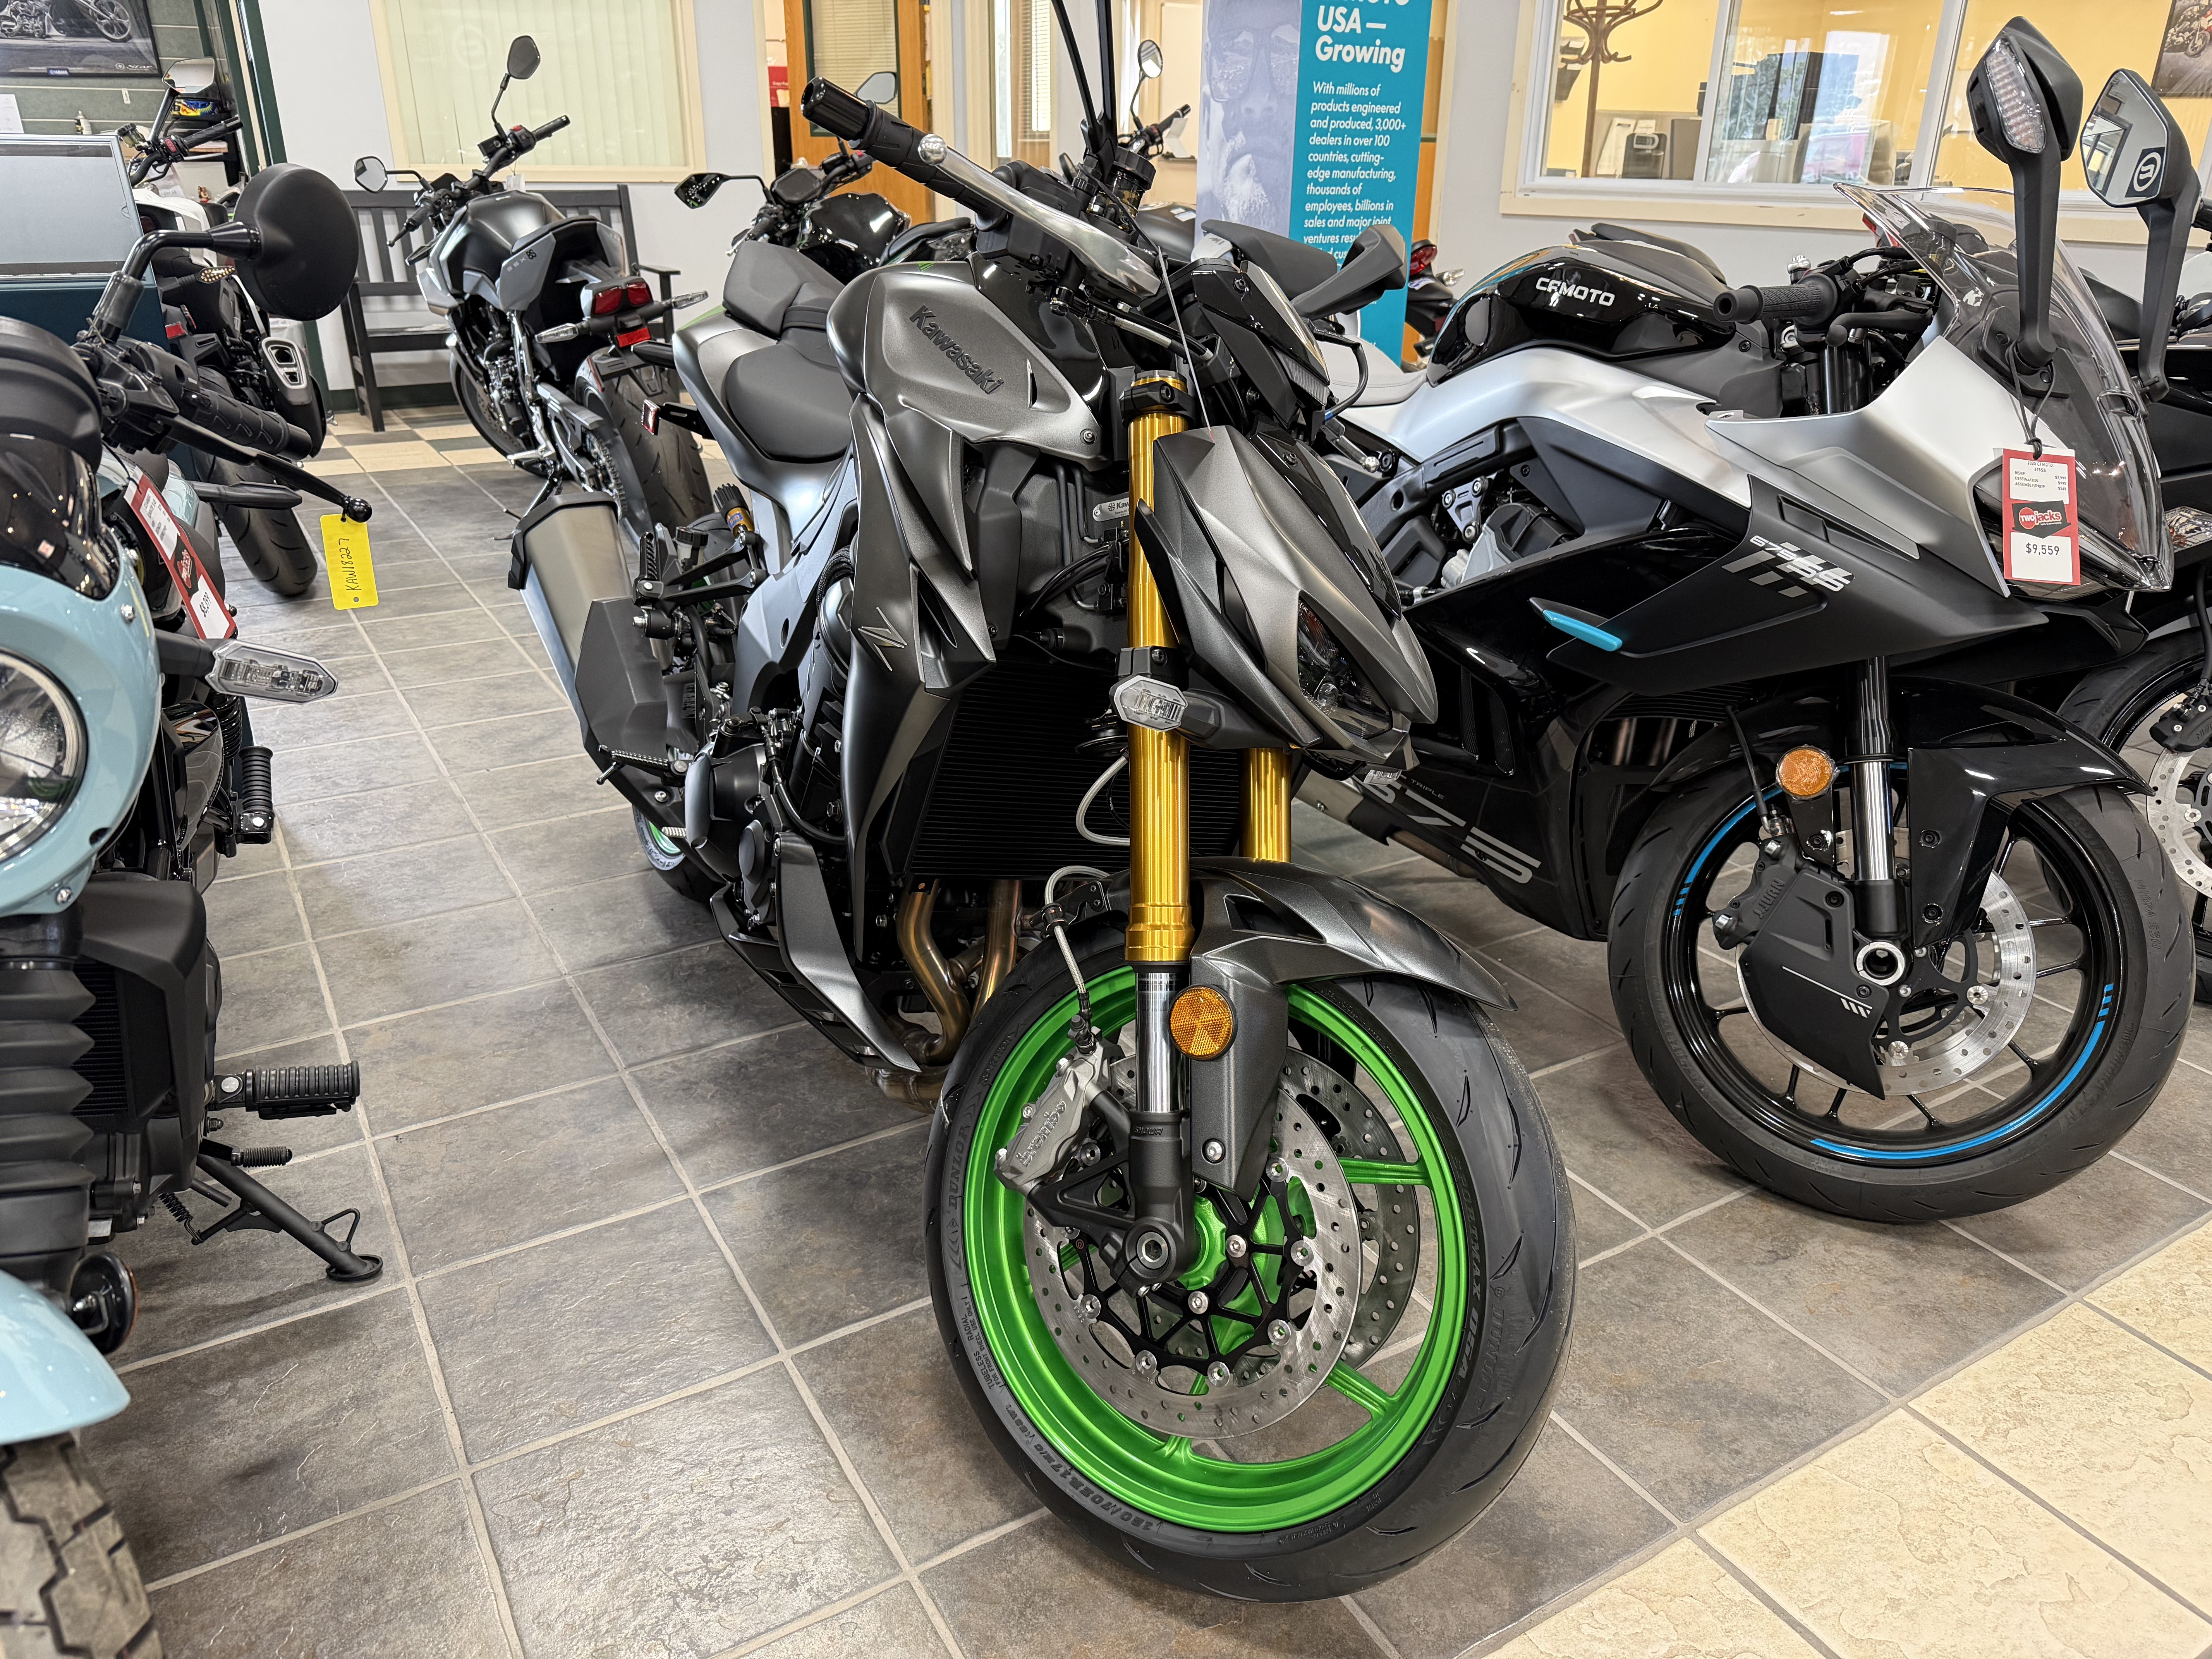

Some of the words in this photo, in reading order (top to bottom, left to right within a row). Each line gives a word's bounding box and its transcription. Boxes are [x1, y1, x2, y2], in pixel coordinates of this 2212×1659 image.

[1317, 5, 1362, 34] USA
[1315, 35, 1406, 73] Growing
[1313, 81, 1335, 94] With
[1336, 82, 1369, 96] millions
[1370, 83, 1382, 96] of
[1310, 98, 1350, 115] products
[1351, 101, 1402, 117] engineered
[1310, 115, 1329, 129] and
[1329, 116, 1374, 132] produced,
[1375, 118, 1407, 132] 3,000+
[1309, 132, 1343, 146] dealers
[1343, 134, 1352, 146] in
[1353, 137, 1374, 146] over
[1374, 134, 1391, 147] 100
[1308, 151, 1349, 164] countries,
[1350, 151, 1384, 167] cutting-
[1307, 165, 1331, 182] edge
[1331, 166, 1396, 183] manufacturing,
[1306, 182, 1351, 195] thousands
[1352, 182, 1363, 195] of
[1305, 199, 1353, 215] employees,
[1354, 199, 1385, 211] billions
[1385, 200, 1394, 211] in
[1304, 215, 1326, 228] sales
[1327, 215, 1346, 228] and
[1346, 216, 1371, 230] major
[1303, 233, 1340, 244] ventures
[1535, 277, 1615, 306] CFMOTO
[909, 304, 1005, 395] Kawasaki
[2025, 542, 2059, 556] $9,559
[1410, 778, 1445, 800] TRIPLE
[1016, 1100, 1067, 1167] brembo
[1134, 1126, 1163, 1136] SHOWA
[964, 1302, 973, 1317] ONLY
[961, 1314, 974, 1341] RADIAL
[969, 1318, 977, 1331] USE
[975, 1332, 985, 1352] WHEEL
[974, 1351, 995, 1389] TUBELESS
[982, 1354, 994, 1372] FRONT
